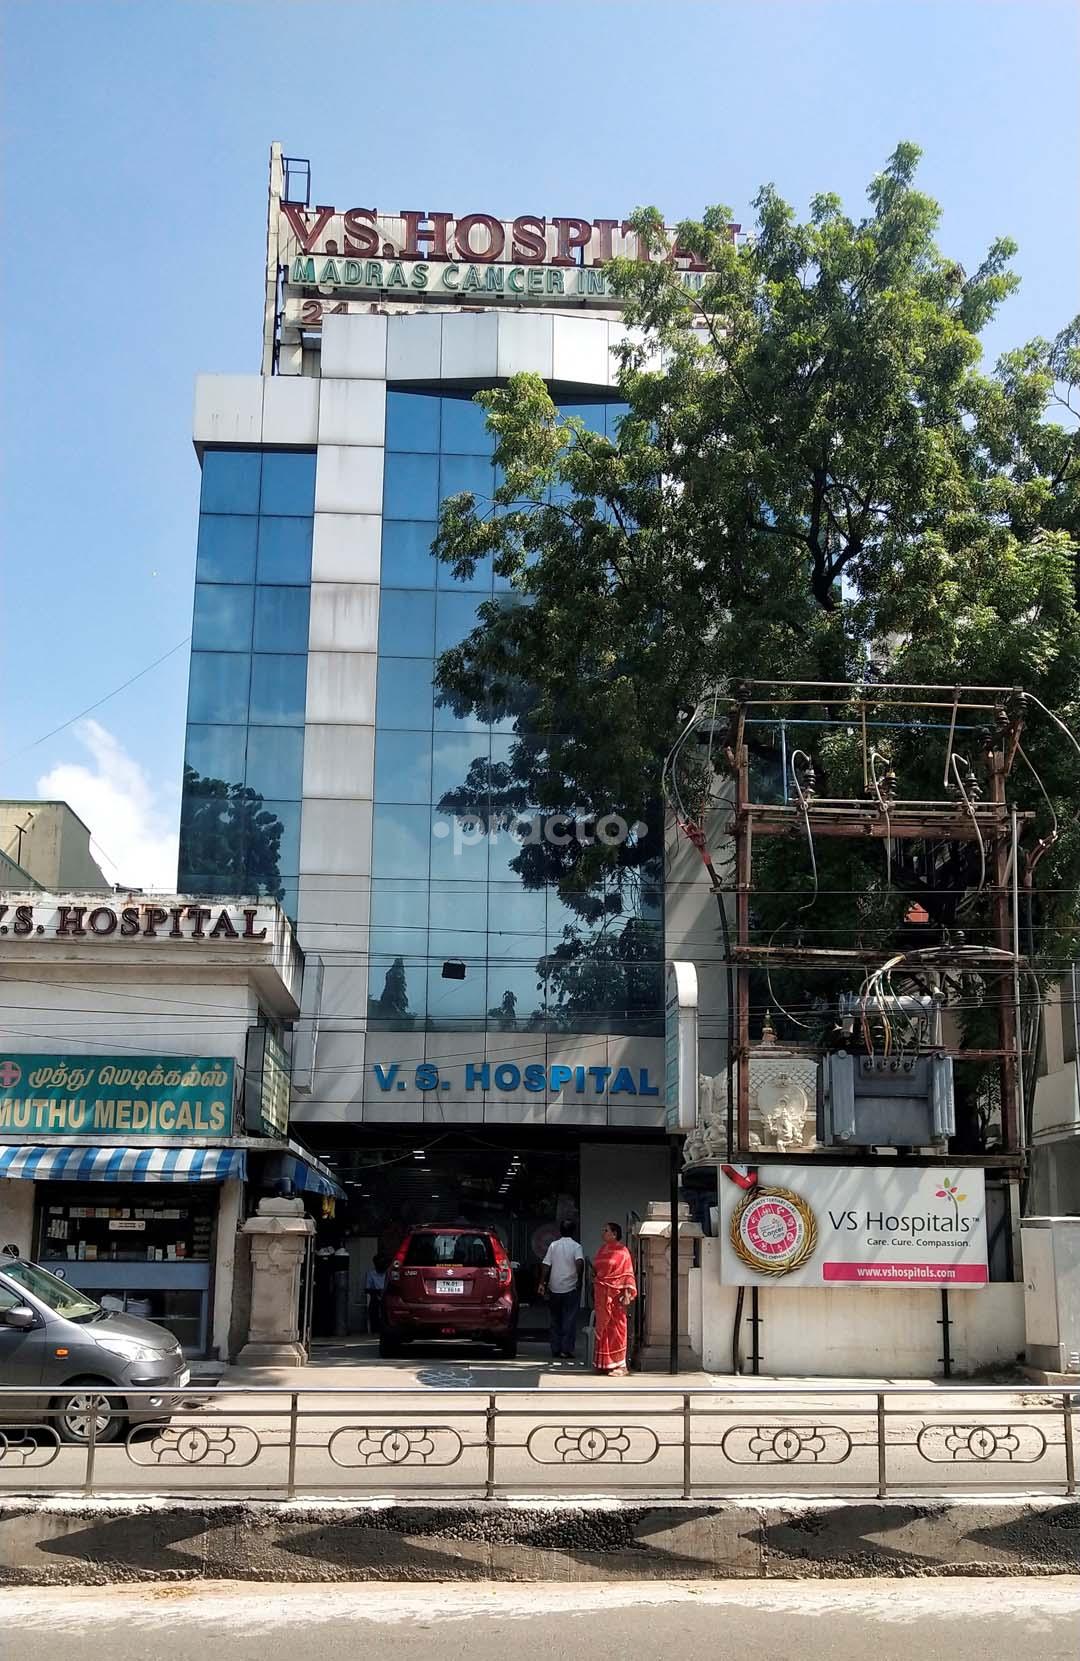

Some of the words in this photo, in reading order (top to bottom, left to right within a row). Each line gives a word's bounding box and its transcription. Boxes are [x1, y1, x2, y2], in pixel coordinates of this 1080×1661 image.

[280, 203, 742, 272] V.S.HOSPITA
[292, 256, 430, 289] MADRAS
[442, 264, 566, 294] CANCER
[56, 905, 267, 938] HOSPITAL
[28, 1061, 95, 1092] முத்து
[465, 1063, 660, 1097] HOSPITAL
[94, 1100, 226, 1131] MEDICALS
[828, 1211, 858, 1231] VS
[866, 1212, 970, 1237] Hospitals
[867, 1238, 889, 1246] Care.
[891, 1238, 914, 1246] Cure.
[916, 1239, 971, 1248] Compassion.
[857, 1266, 956, 1279] www.vshospitals.com
